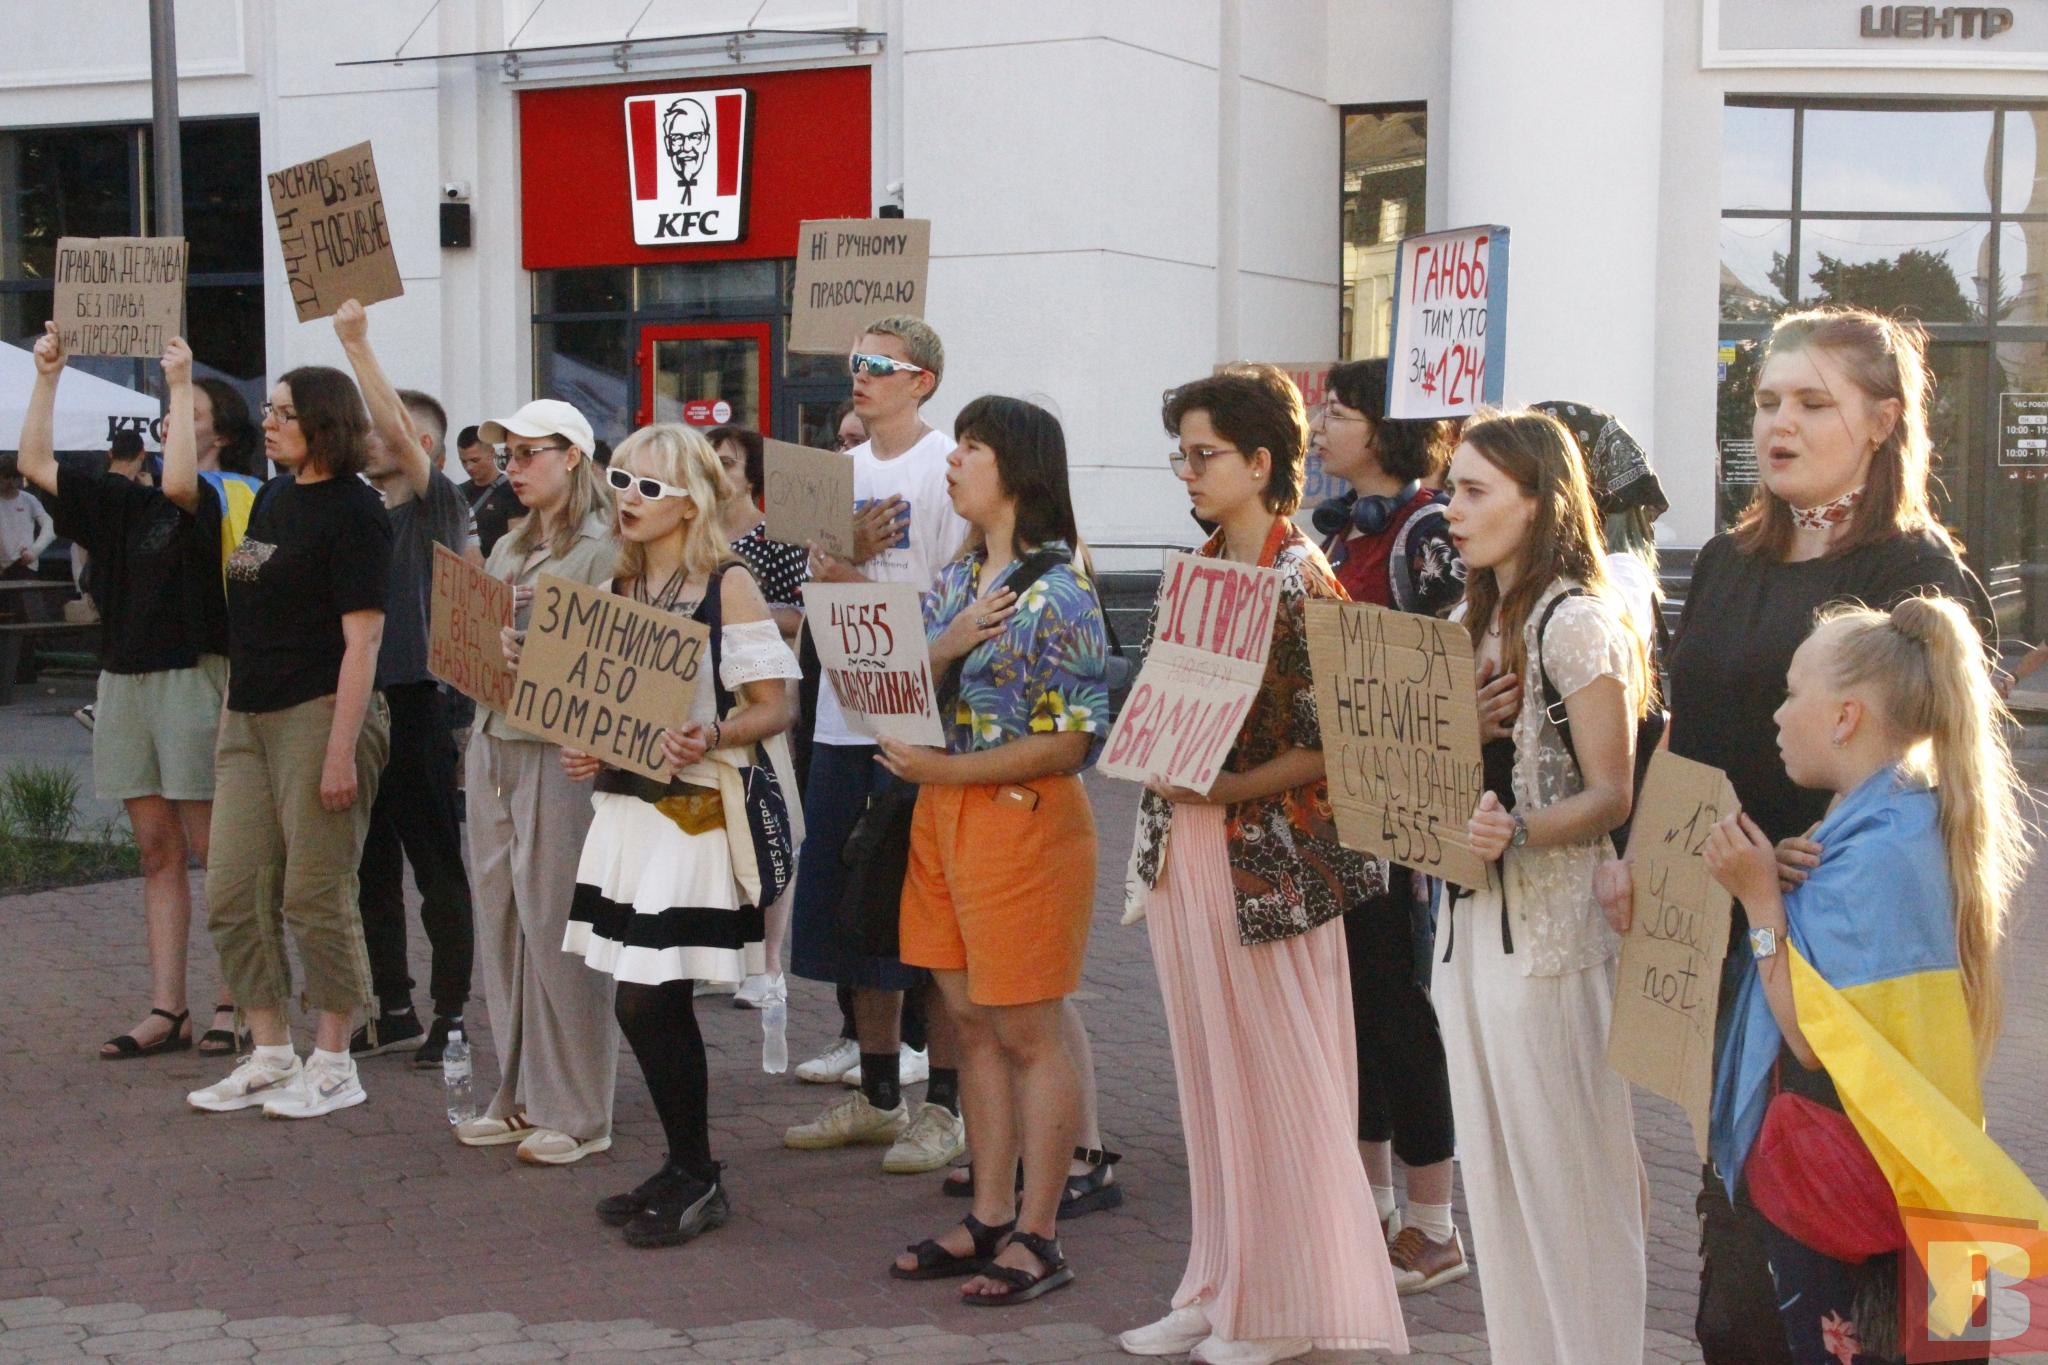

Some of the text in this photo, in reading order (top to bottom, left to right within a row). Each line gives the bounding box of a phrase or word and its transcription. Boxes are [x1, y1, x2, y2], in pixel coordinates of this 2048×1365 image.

[1860, 5, 2014, 40] ЦЕНТР
[267, 162, 319, 199] РУСНЯ
[310, 200, 389, 272] ДОБИВАЄ
[654, 210, 720, 238] KFC
[837, 233, 908, 257] РУЧНОМУ
[58, 246, 182, 284] ПРАВОВА ДЕРЖАВА
[1412, 236, 1489, 304] ГАНЬБ
[77, 293, 145, 318] БЕЗ ПРАВА
[810, 280, 915, 308] ПРАВОСУДДЮ
[1458, 307, 1487, 339] ХТО
[1410, 348, 1427, 383] ЗА
[2006, 426, 2028, 434] 10:00
[2006, 449, 2028, 457] 10:00
[539, 586, 701, 682] ЗМІНИМОСЬ
[831, 602, 894, 656] 4555
[1338, 604, 1453, 690] МИ ЗА
[566, 651, 637, 703] АБО
[514, 680, 668, 771] ПОМРЕМО
[1335, 674, 1450, 751] НЕГАЙНЕ
[1108, 683, 1248, 783] ВАМИ!
[1341, 742, 1484, 826] СКАСУВАННЯ
[768, 838, 780, 847] A
[1382, 803, 1443, 866] 4555
